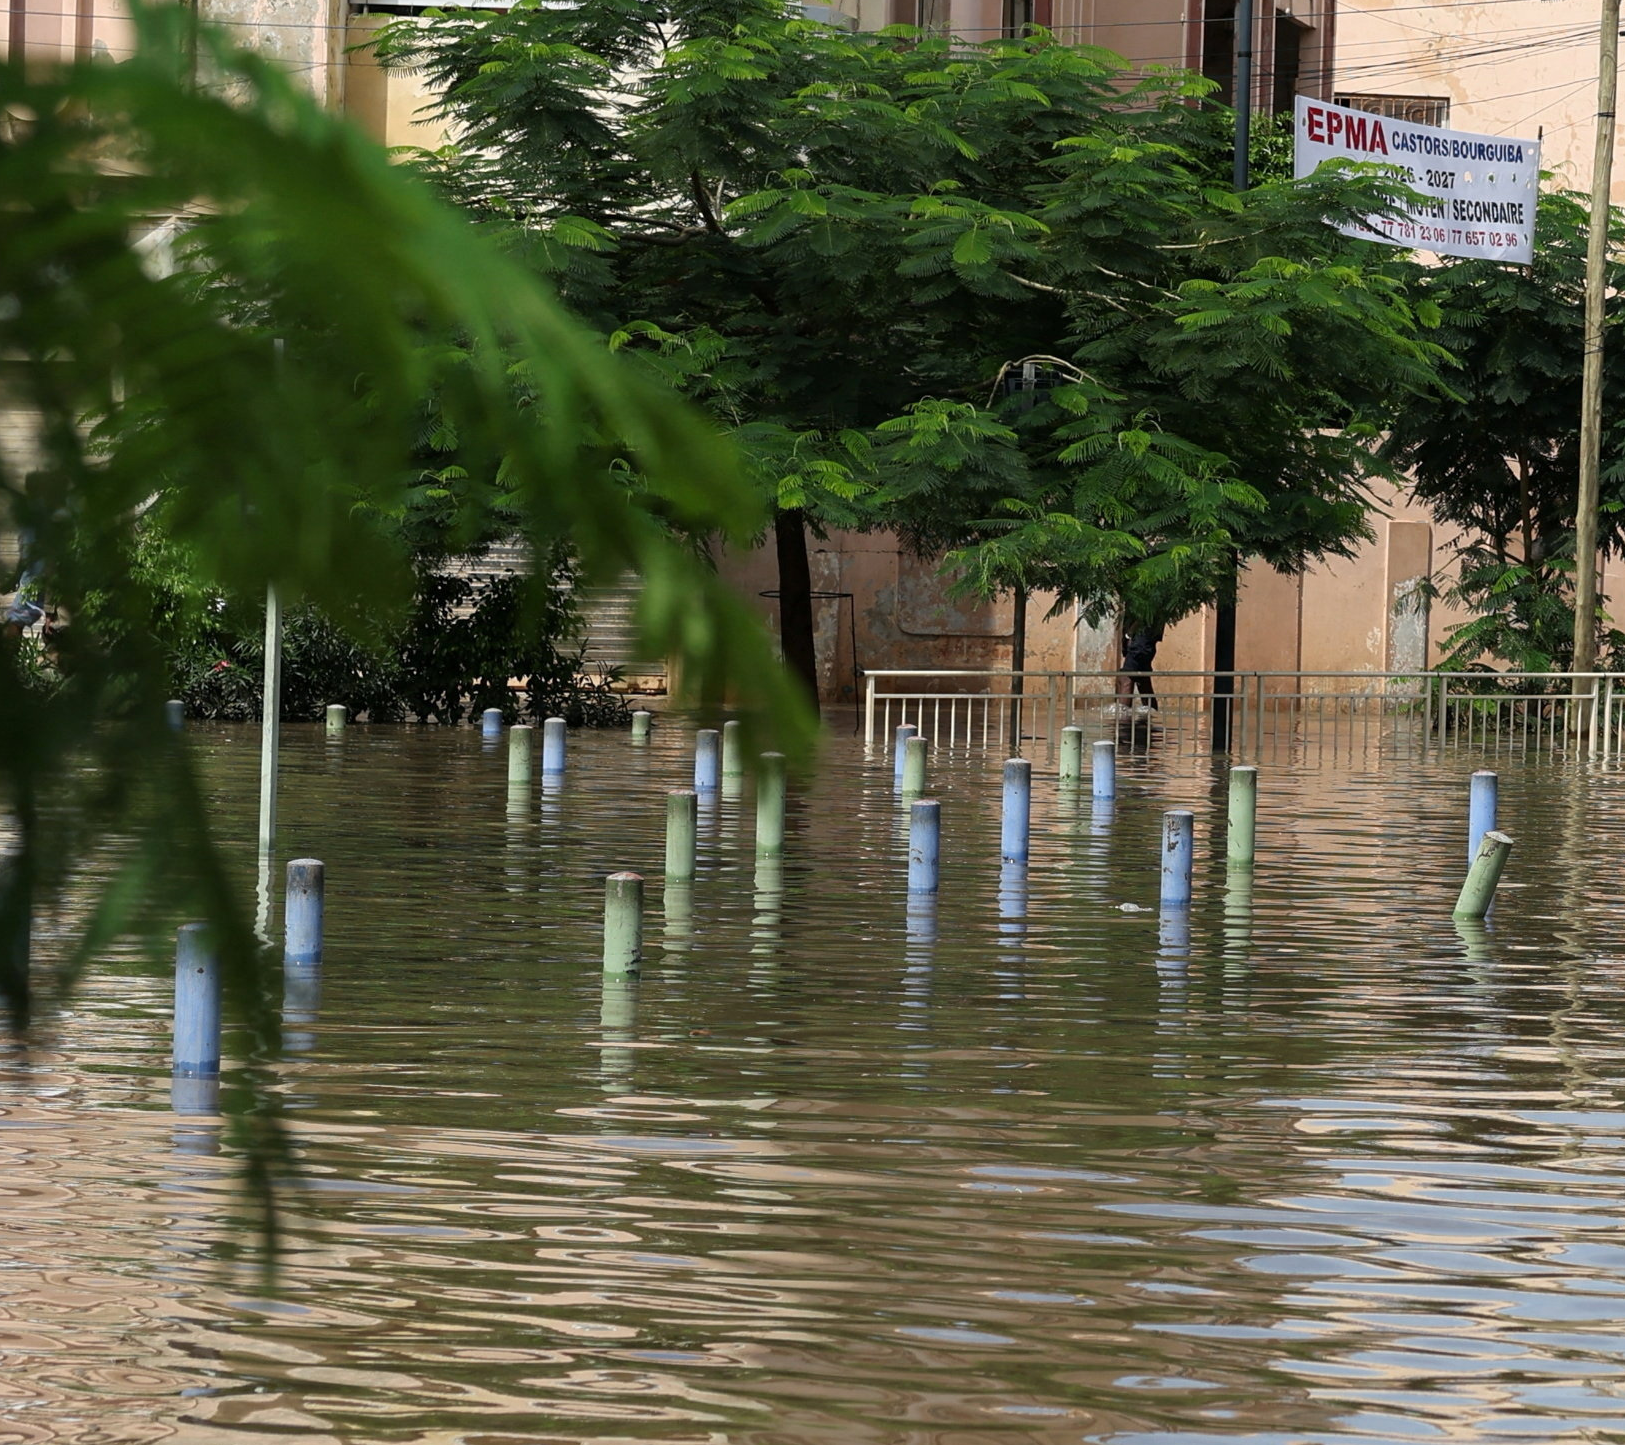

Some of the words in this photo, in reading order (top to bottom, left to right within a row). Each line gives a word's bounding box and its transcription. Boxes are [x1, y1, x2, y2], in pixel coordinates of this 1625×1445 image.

[1307, 106, 1388, 155] EPMA
[1392, 130, 1523, 163] CASTORS/BOURGUIBA
[1426, 169, 1455, 189] 2027
[1453, 198, 1524, 225] SECONDAIRE
[1381, 220, 1394, 236] 77
[1398, 222, 1416, 239] 781
[1419, 225, 1432, 241] 23
[1433, 227, 1445, 243] 06
[1452, 229, 1462, 245] 77
[1465, 230, 1486, 246] 657
[1489, 232, 1503, 247] 02
[1505, 233, 1518, 247] 96
